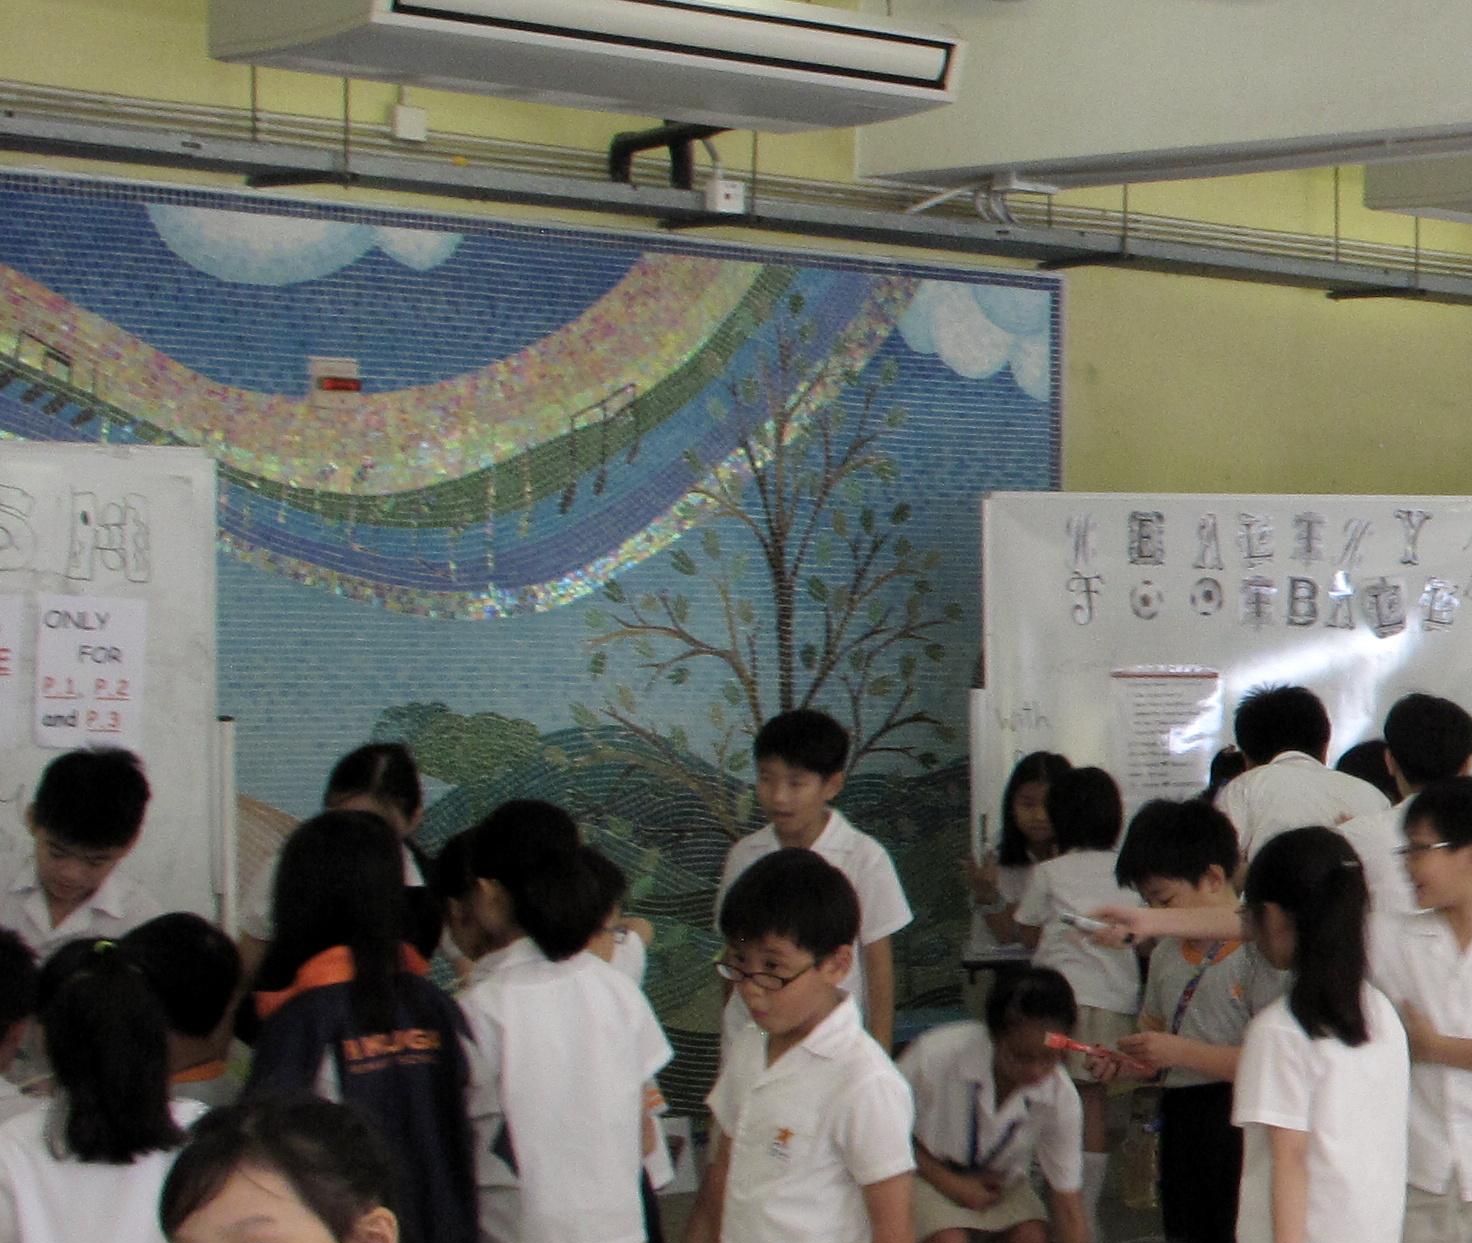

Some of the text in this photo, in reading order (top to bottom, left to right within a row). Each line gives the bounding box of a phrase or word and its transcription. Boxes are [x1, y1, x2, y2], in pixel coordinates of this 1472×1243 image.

[43, 609, 112, 630] ONLY
[78, 644, 124, 664] FOR
[41, 707, 79, 728] and
